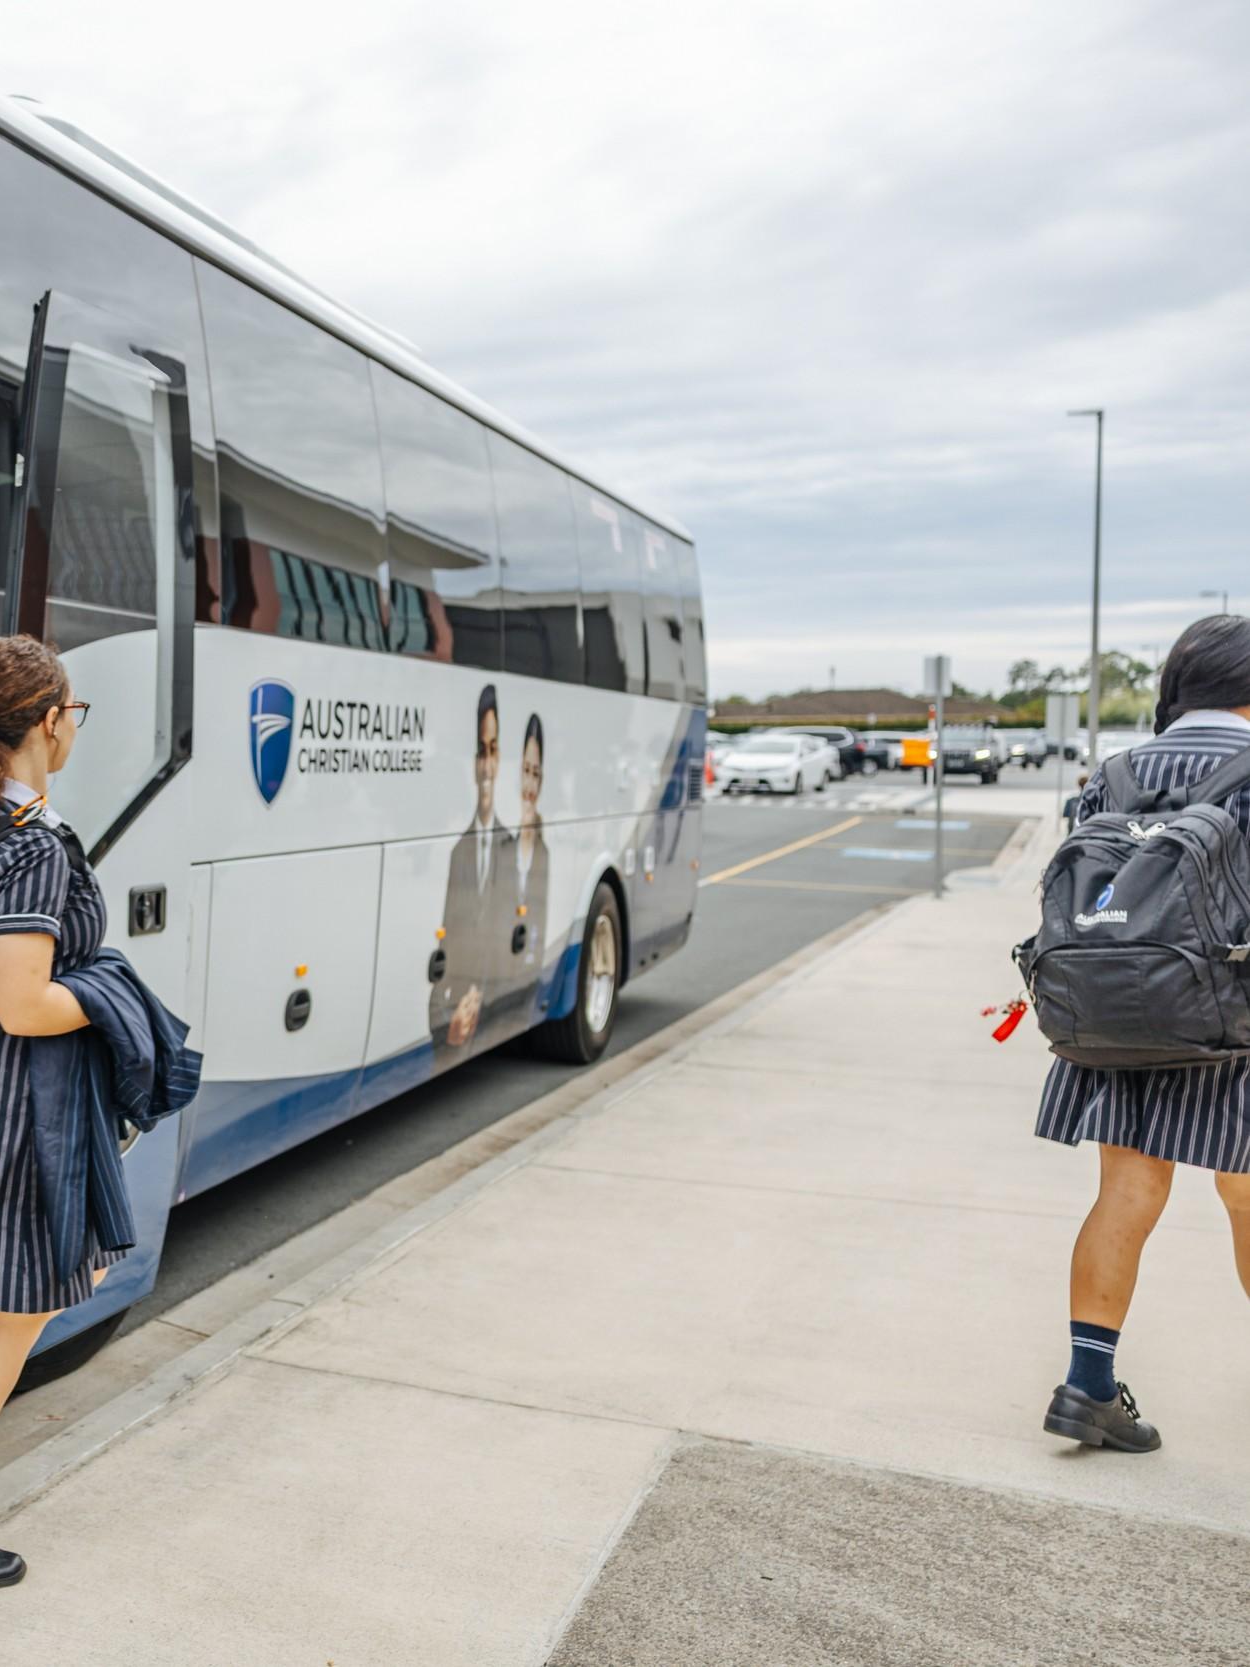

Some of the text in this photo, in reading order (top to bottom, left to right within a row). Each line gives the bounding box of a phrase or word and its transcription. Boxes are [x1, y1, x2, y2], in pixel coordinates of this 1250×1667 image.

[299, 699, 425, 741] AUSTRALIAN
[298, 749, 422, 773] CHRISTIAN COLLEGE
